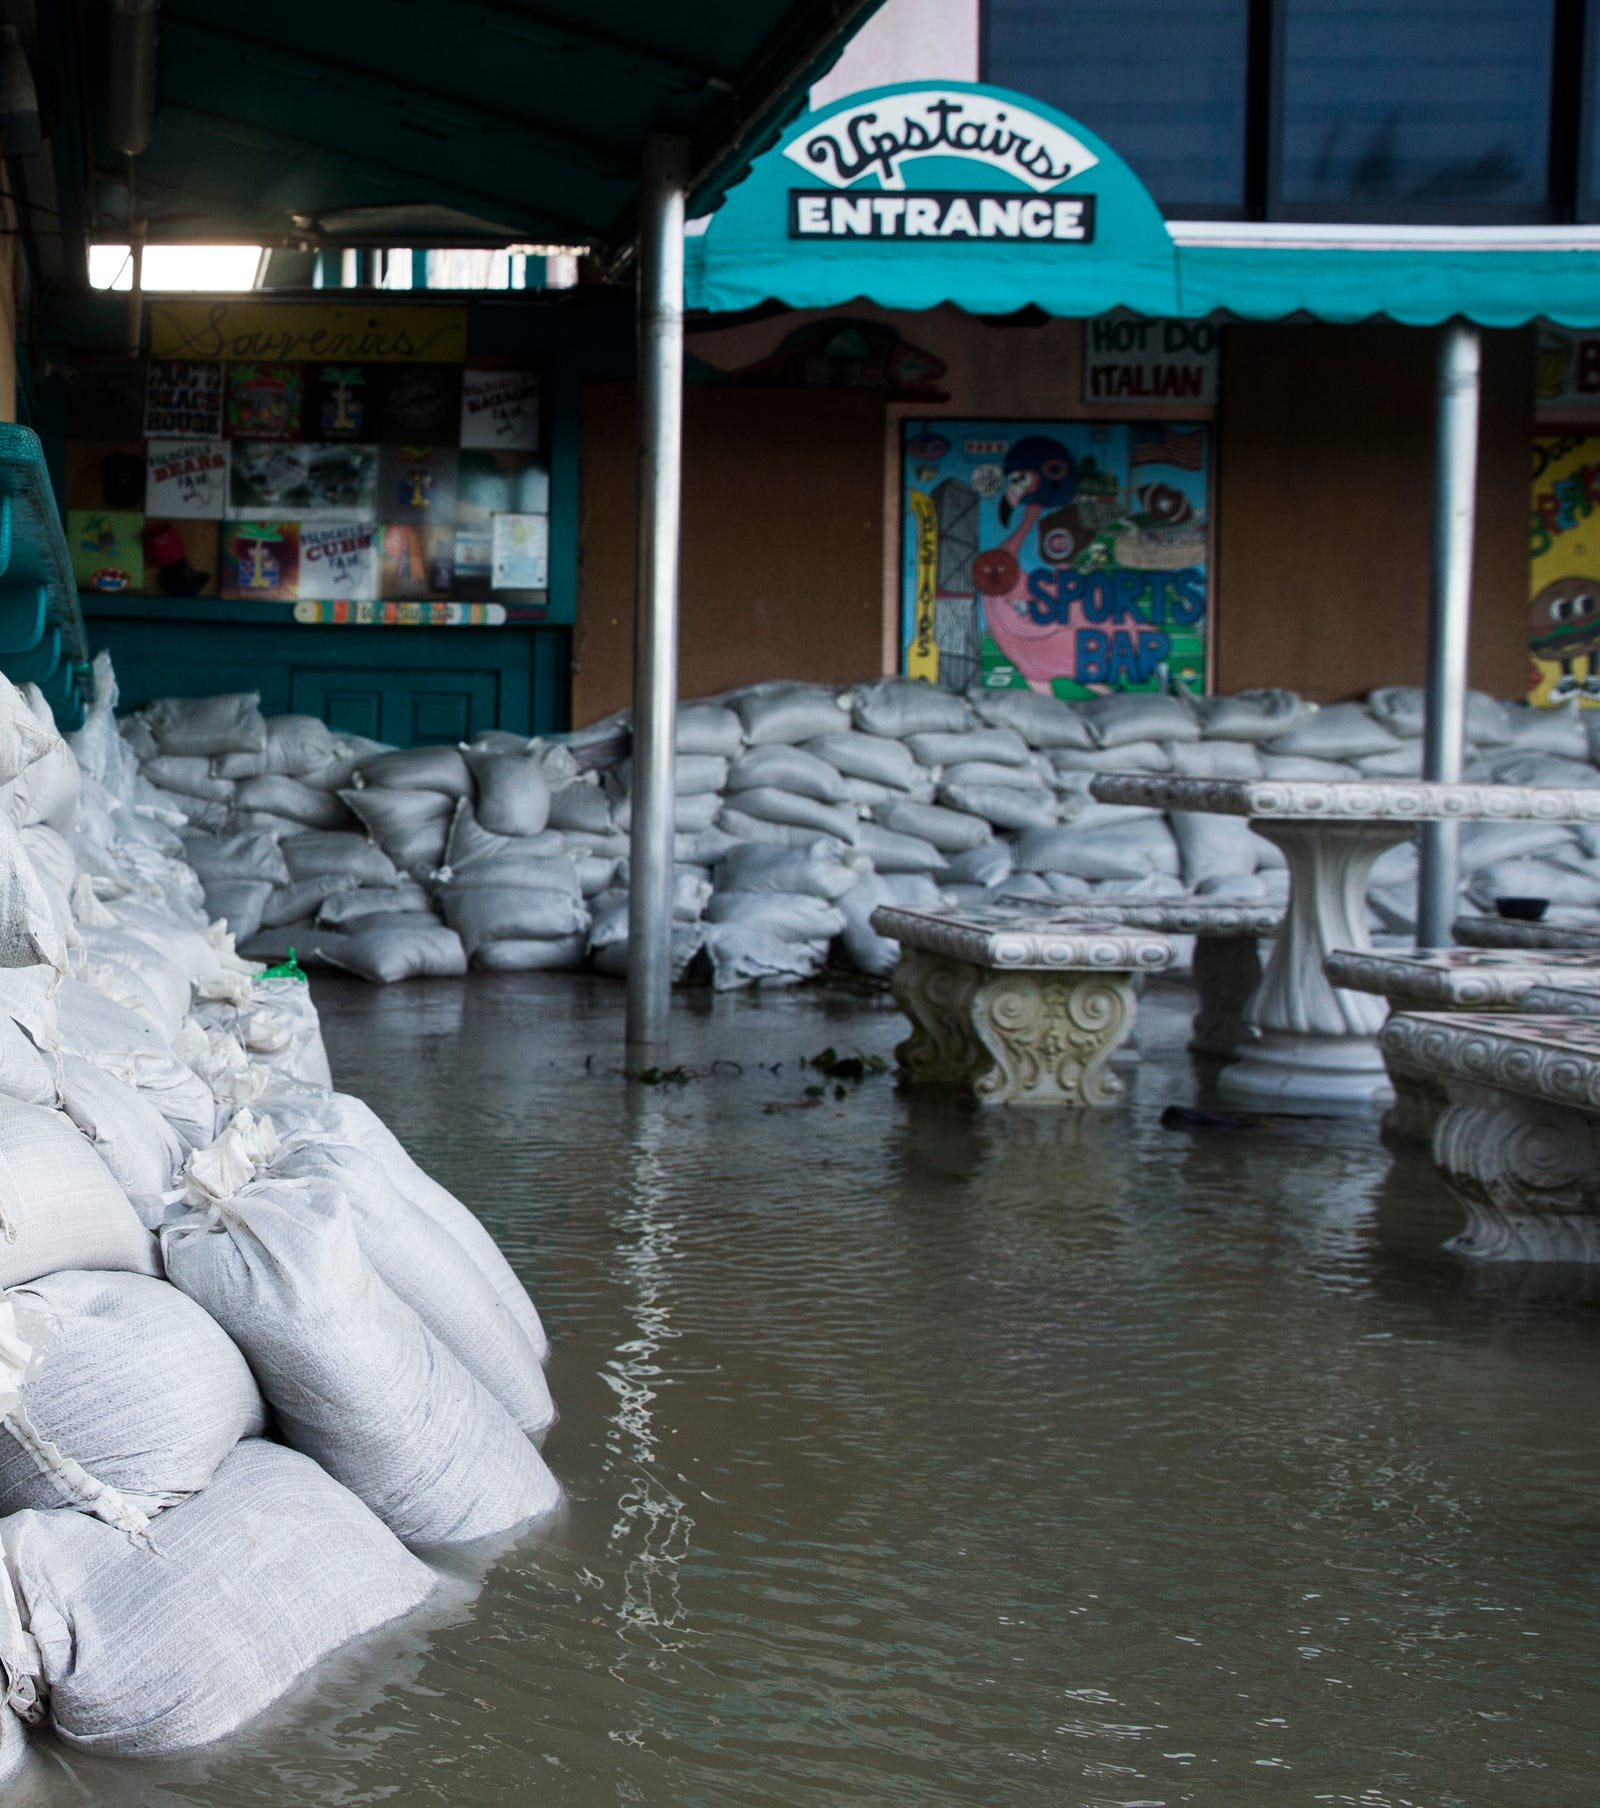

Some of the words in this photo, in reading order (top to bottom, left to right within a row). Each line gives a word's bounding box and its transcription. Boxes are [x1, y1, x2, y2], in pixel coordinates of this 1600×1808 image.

[806, 98, 1071, 181] Upstairs
[797, 196, 1085, 240] ENTRANCE
[155, 304, 461, 357] Souvenirs
[1093, 321, 1155, 351] HOT
[1091, 364, 1203, 396] ITALIAN
[153, 453, 226, 483] BEARS
[305, 535, 370, 561] CUBS
[1028, 567, 1205, 625] SPORTS
[1076, 629, 1170, 683] BAR
